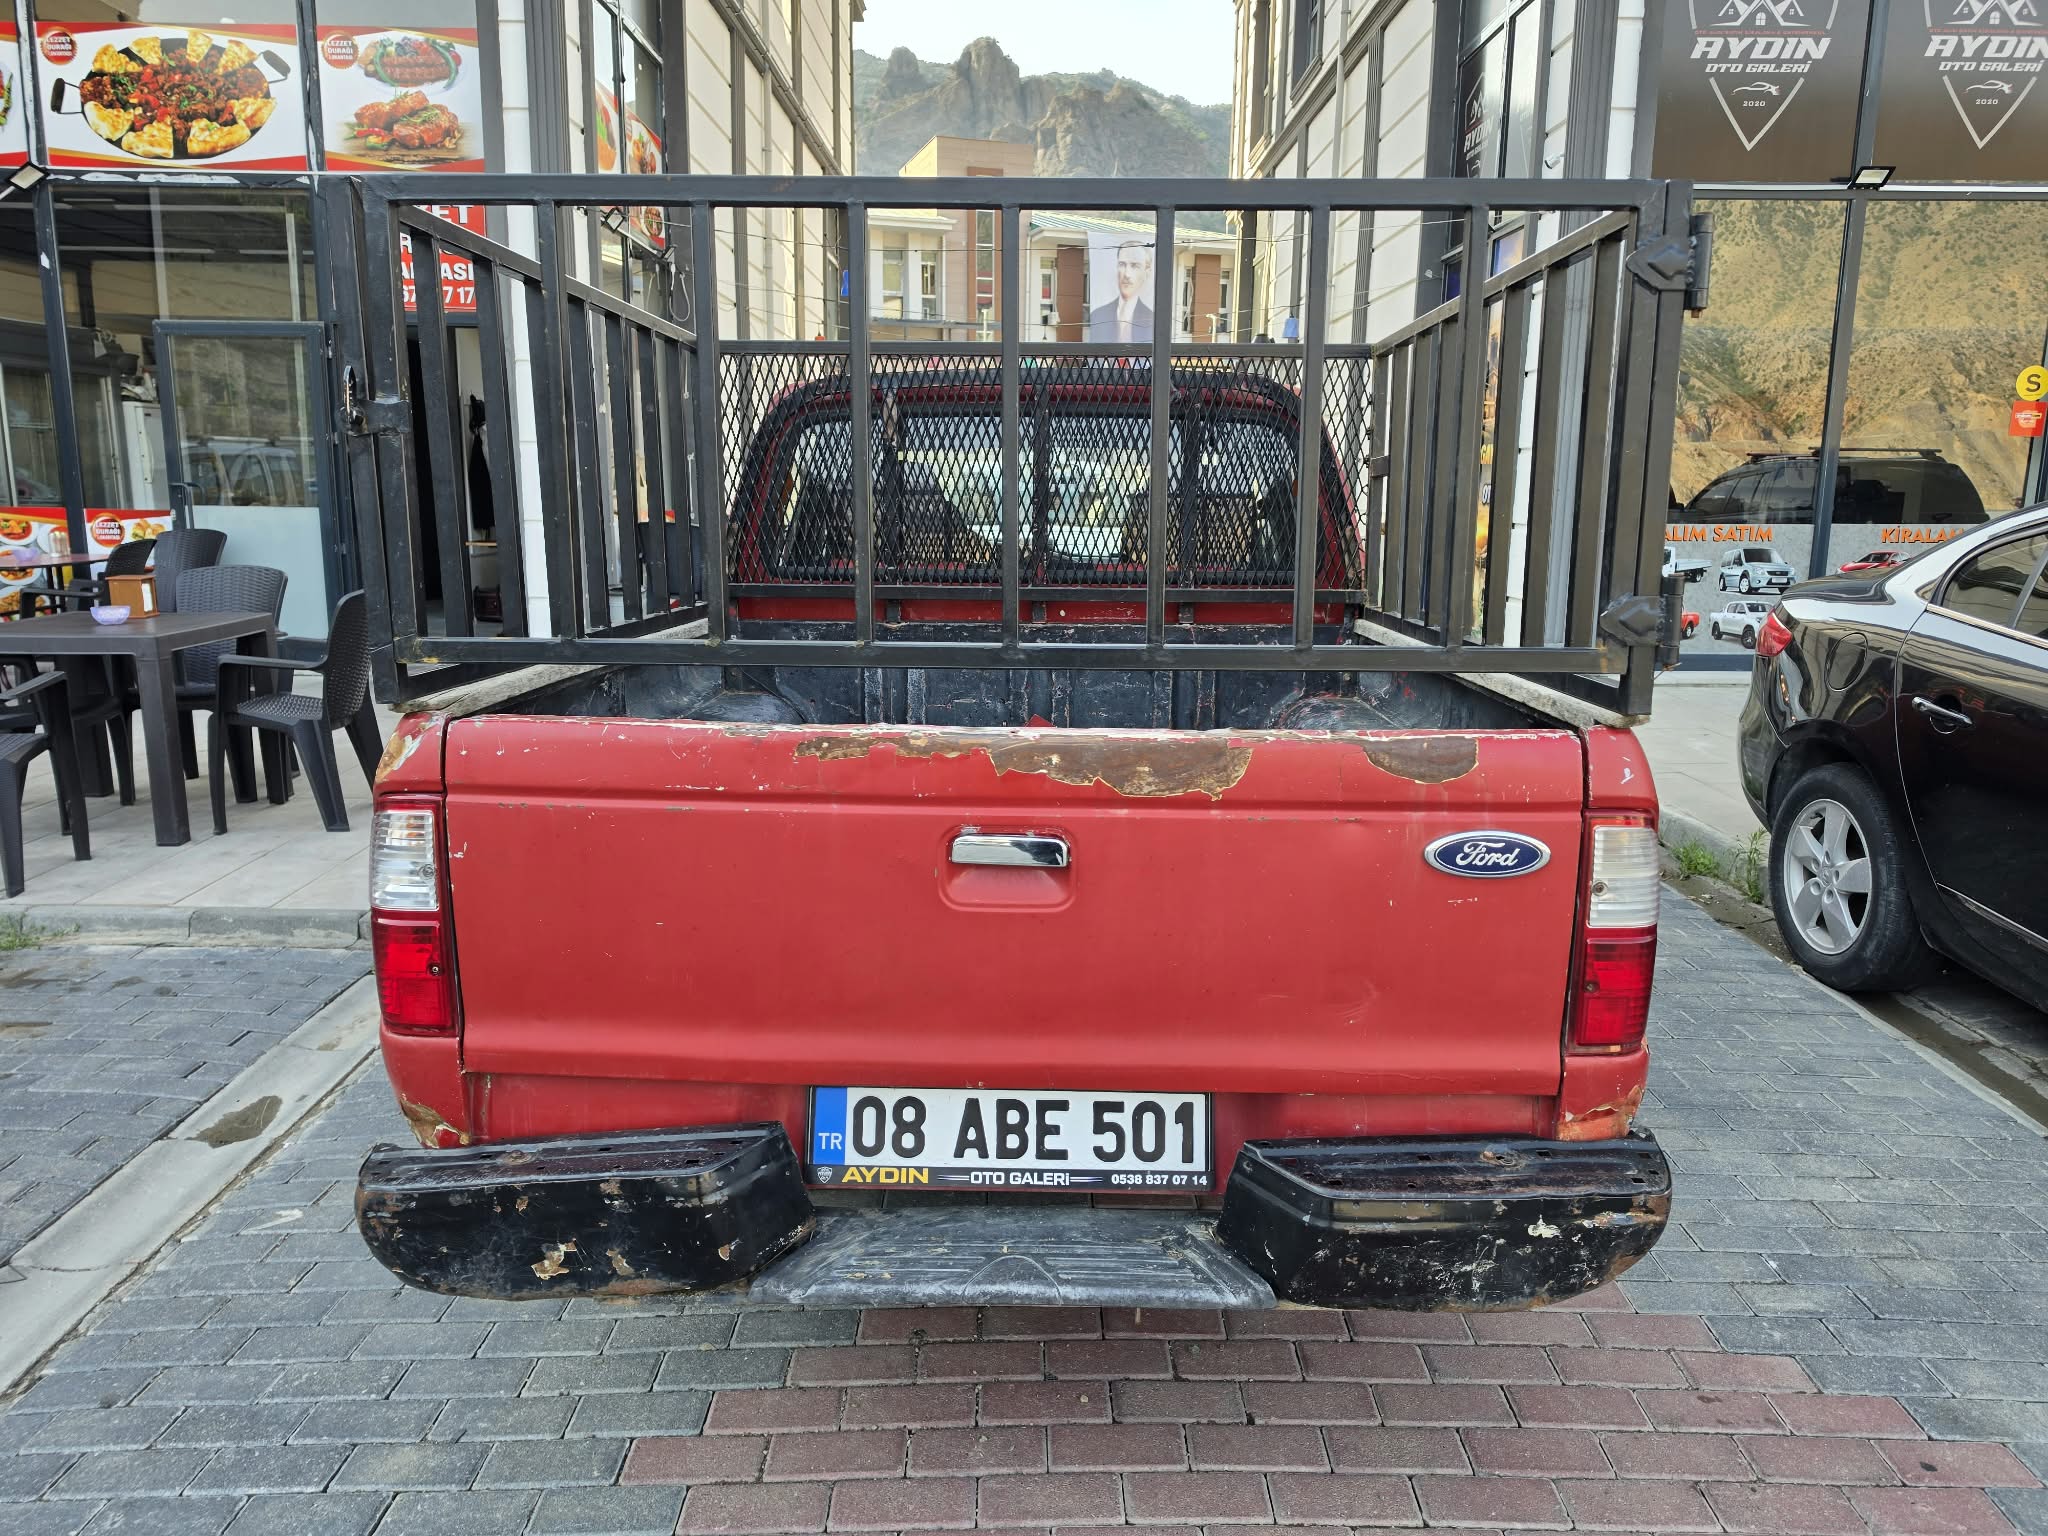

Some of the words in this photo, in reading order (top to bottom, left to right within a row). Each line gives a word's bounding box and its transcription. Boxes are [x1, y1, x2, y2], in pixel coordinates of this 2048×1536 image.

[1690, 37, 1832, 59] AYDIN
[1705, 63, 1743, 73] OTO
[1745, 60, 1812, 73] GALERİ
[1938, 61, 1977, 71] OTO
[1978, 59, 2045, 72] GALERİ
[2025, 373, 2041, 392] S
[1665, 525, 1706, 542] ALIM
[1713, 524, 1773, 542] SATIM
[1455, 841, 1520, 866] Ford
[853, 1096, 926, 1158] 08
[953, 1097, 1069, 1161] ABE
[1093, 1101, 1194, 1164] 501
[818, 1132, 842, 1150] TR
[842, 1166, 929, 1184] AYDIN
[970, 1171, 1005, 1185] OTO
[1111, 1174, 1142, 1185] 0538
[1145, 1174, 1168, 1185] 837
[1172, 1175, 1188, 1185] 07
[1192, 1175, 1207, 1185] 14
